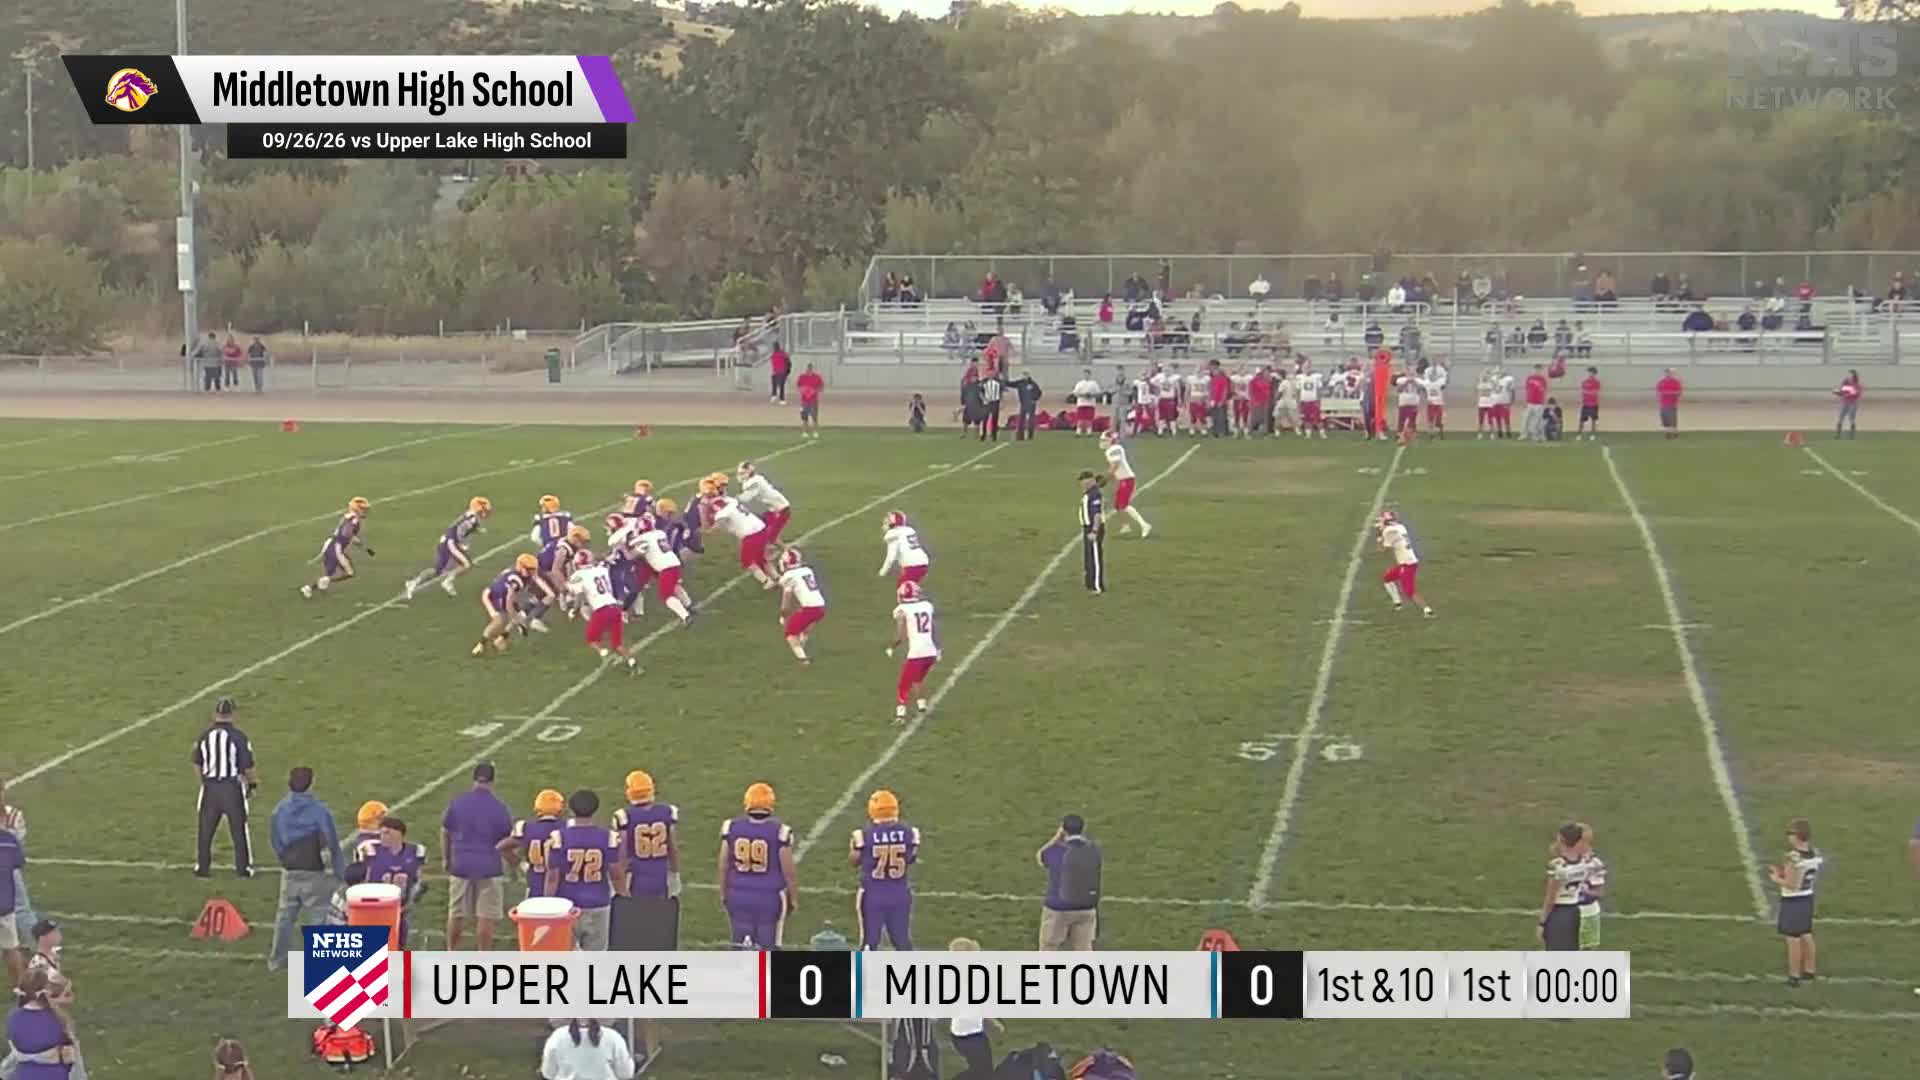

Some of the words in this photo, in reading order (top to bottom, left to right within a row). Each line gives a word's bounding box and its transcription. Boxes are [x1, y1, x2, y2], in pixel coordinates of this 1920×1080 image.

[914, 611, 929, 633] 12
[634, 821, 668, 858] 62
[734, 837, 768, 873] 99
[565, 848, 603, 882] 72
[871, 844, 907, 880] 75
[200, 906, 225, 937] 40
